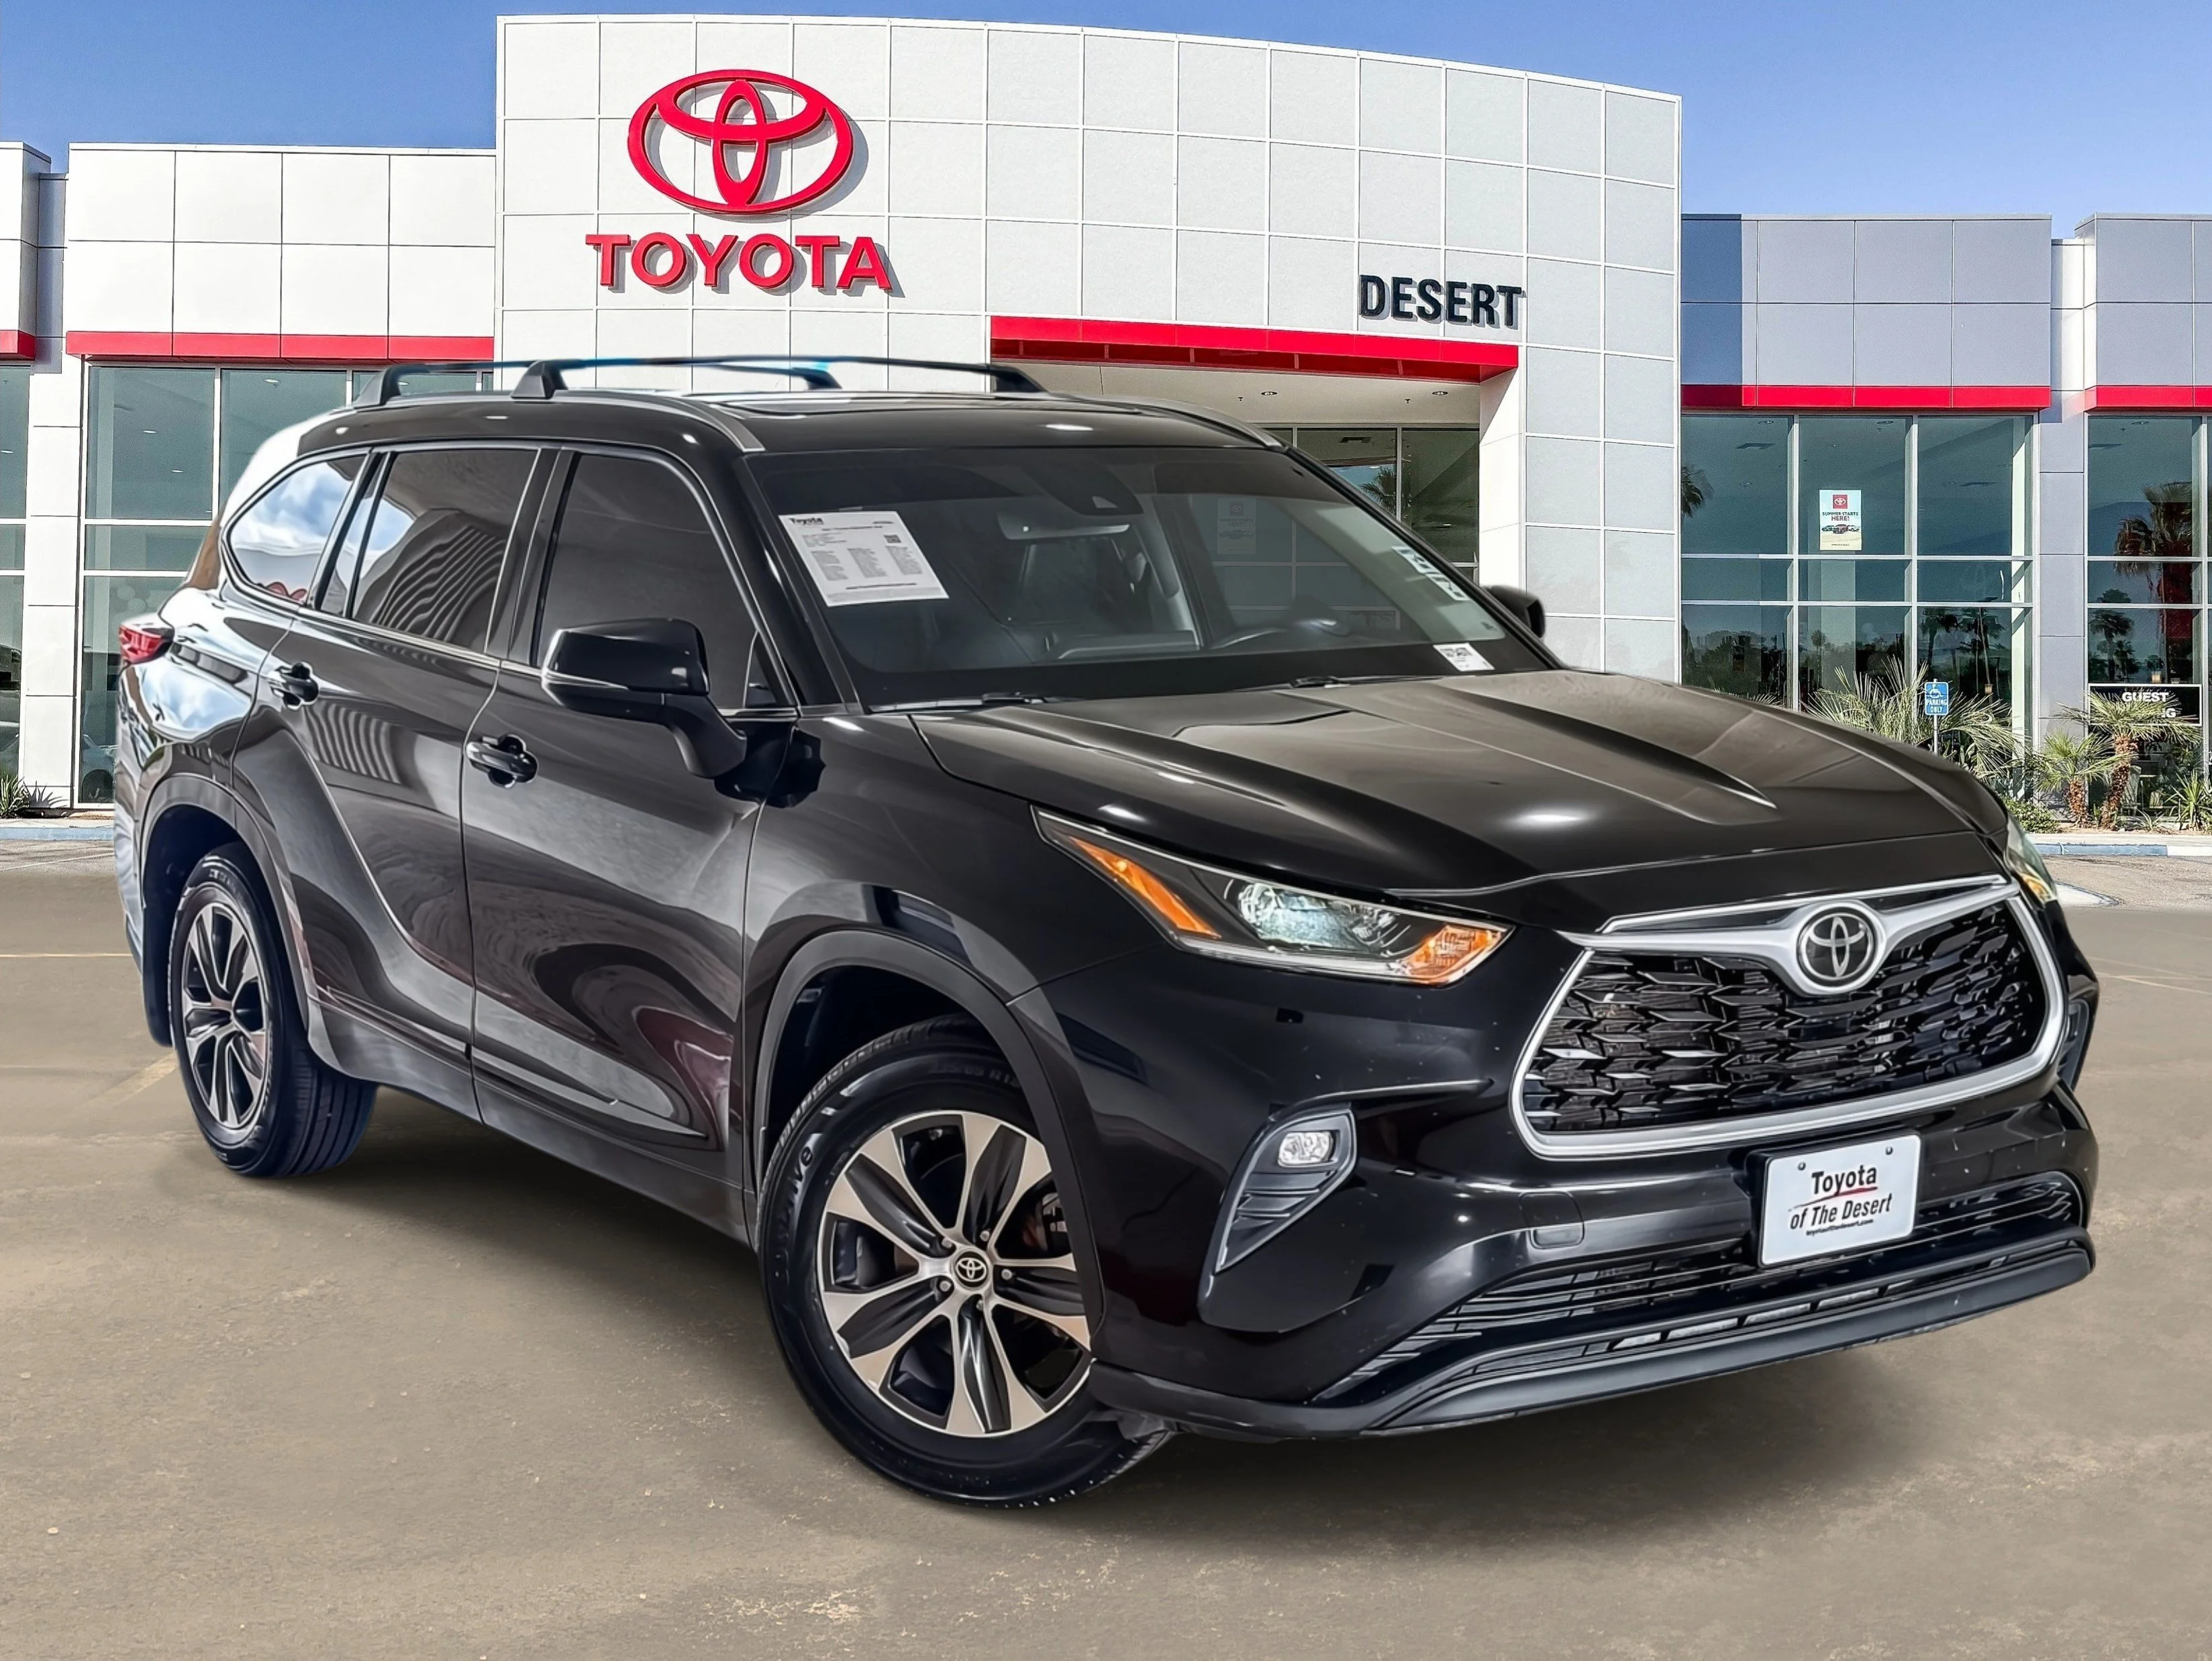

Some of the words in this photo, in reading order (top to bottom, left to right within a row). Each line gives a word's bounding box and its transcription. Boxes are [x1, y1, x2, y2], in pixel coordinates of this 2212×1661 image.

[585, 232, 892, 291] TOYOTA
[1358, 274, 1522, 328] DESERT
[2121, 691, 2169, 702] GUEST
[1811, 1164, 1876, 1196] Toyota
[1790, 1207, 1808, 1229] of
[1811, 1205, 1837, 1226] The
[1842, 1193, 1893, 1219] Desert
